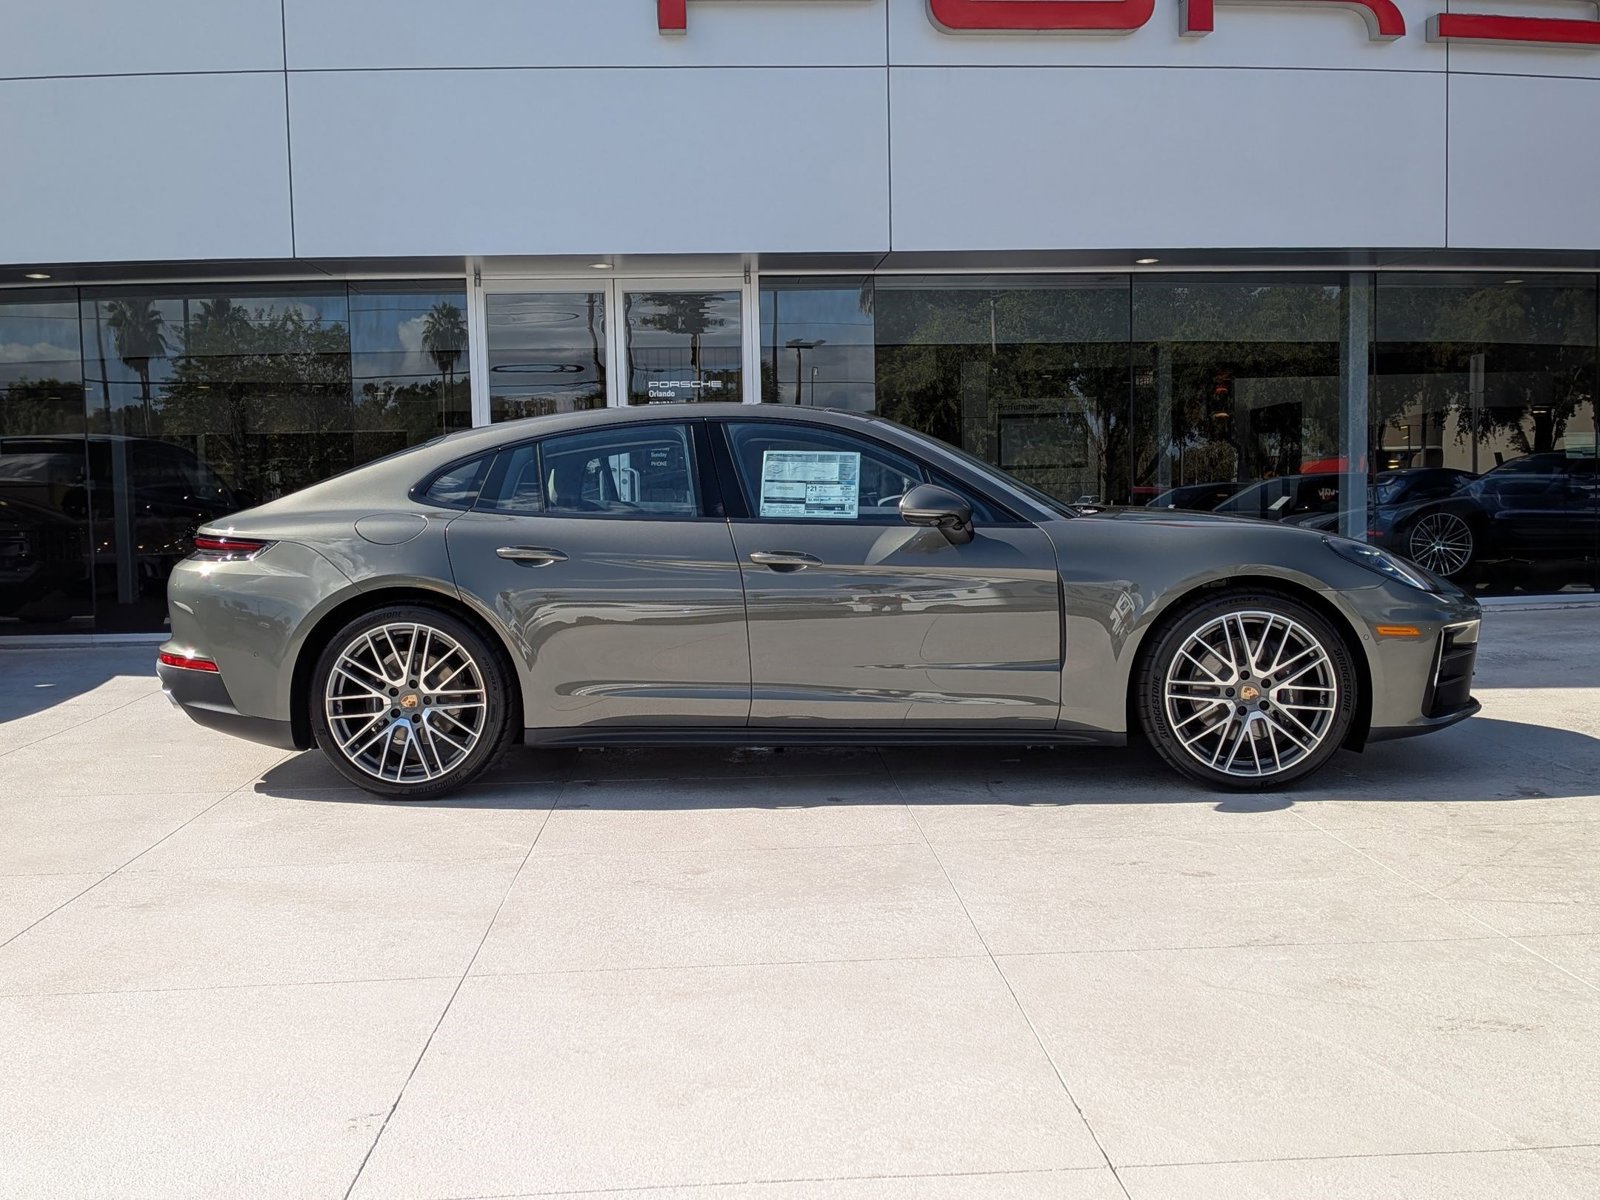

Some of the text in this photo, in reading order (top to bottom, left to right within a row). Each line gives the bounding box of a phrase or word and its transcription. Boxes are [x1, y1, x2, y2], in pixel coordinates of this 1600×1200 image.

[648, 380, 722, 388] PORSCHE
[648, 390, 675, 398] Orlando
[1333, 647, 1353, 713] BRIDGESTONE
[1150, 675, 1169, 739] BRIDGESTONE
